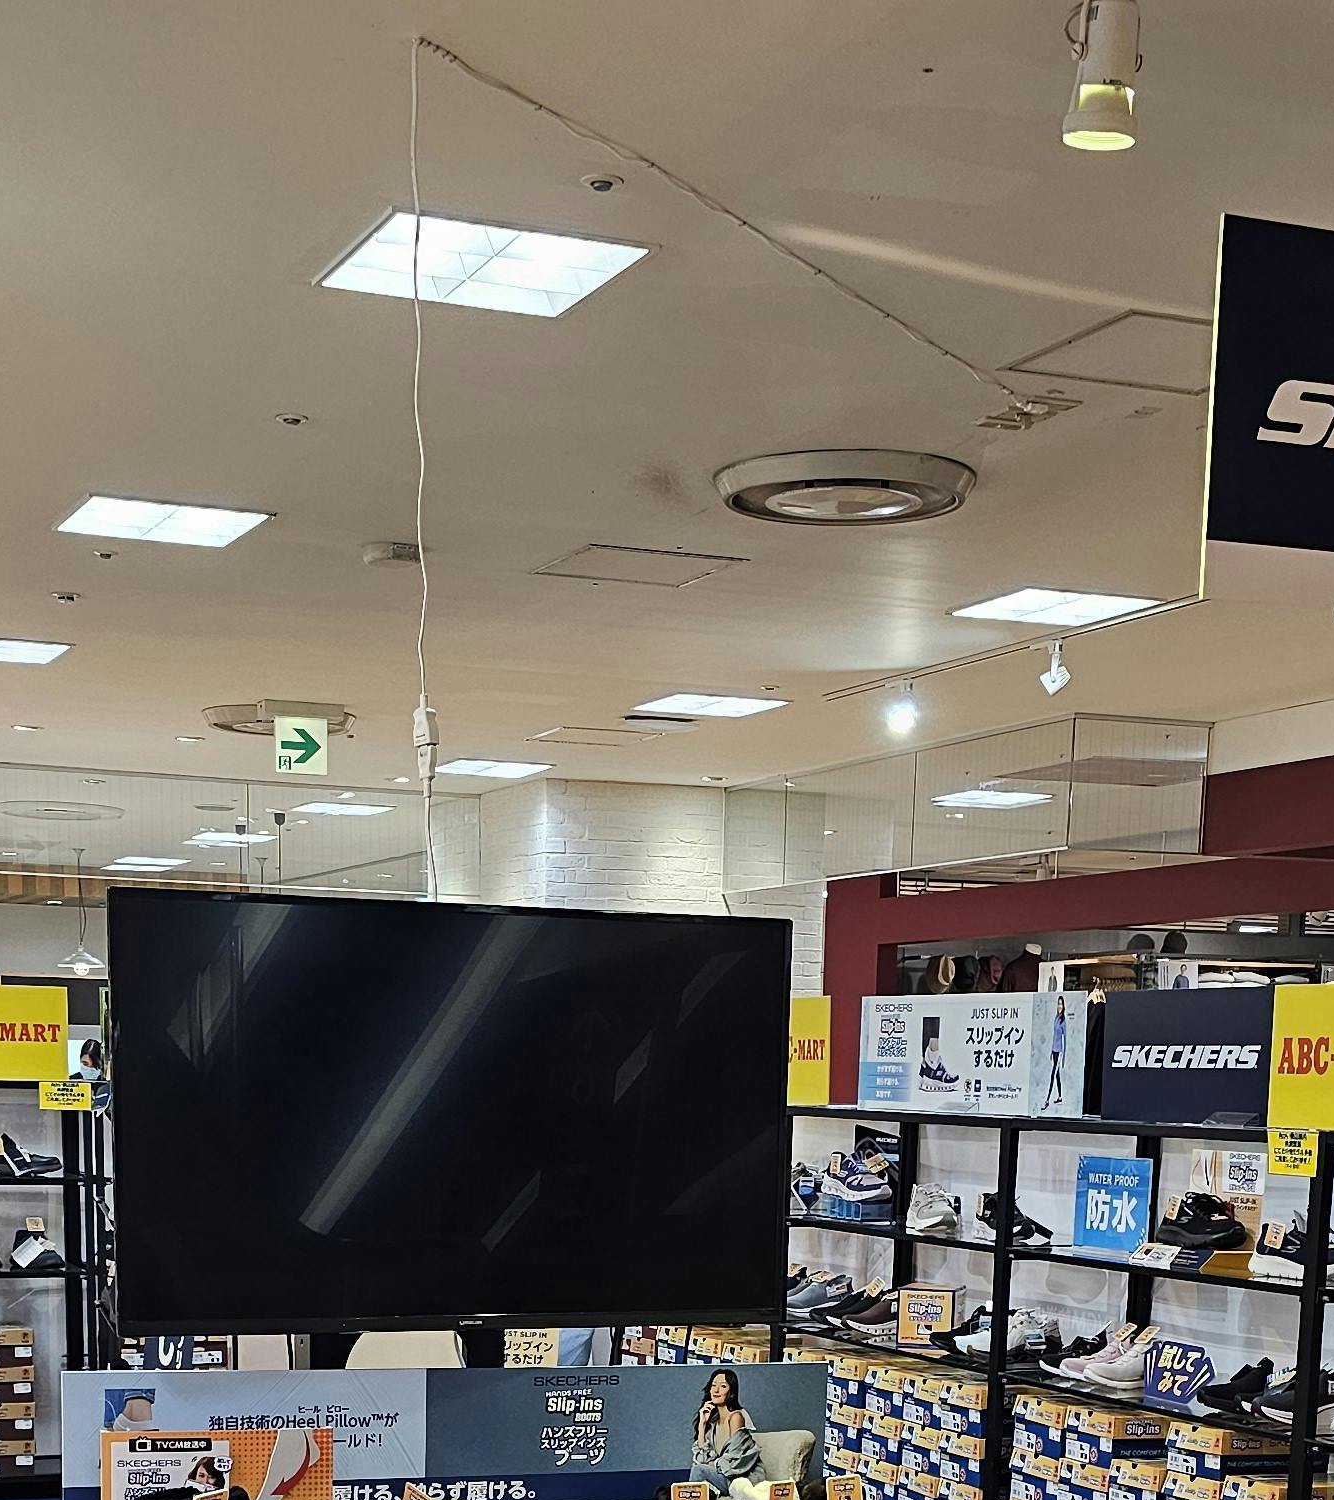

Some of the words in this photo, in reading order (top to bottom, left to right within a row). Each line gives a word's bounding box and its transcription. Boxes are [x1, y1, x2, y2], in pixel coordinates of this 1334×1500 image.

[971, 1009, 990, 1019] JUST
[992, 1008, 1009, 1018] SLIP
[1010, 1008, 1019, 1018] IN
[966, 1026, 1025, 1046] スリップイン
[973, 1049, 1015, 1068] するだけ
[1112, 1045, 1261, 1069] SKECHERS
[1089, 1173, 1113, 1185] WATER
[1115, 1175, 1140, 1187] PROOF
[1085, 1189, 1137, 1233] 防水
[1158, 1345, 1202, 1372] 試して
[534, 1375, 619, 1387] SKECHERS
[1157, 1371, 1189, 1396] みて
[298, 1405, 321, 1414] ヒール
[326, 1405, 349, 1413] ピロー
[547, 1397, 603, 1414] Slip-ins
[574, 1413, 602, 1422] BOOTS
[541, 1425, 608, 1439] ハンズフリー
[1125, 1423, 1160, 1435] Slip-ins
[540, 1437, 606, 1449] スリップインズ
[554, 1447, 605, 1466] ブーツ
[128, 1473, 170, 1485] Slip-ins
